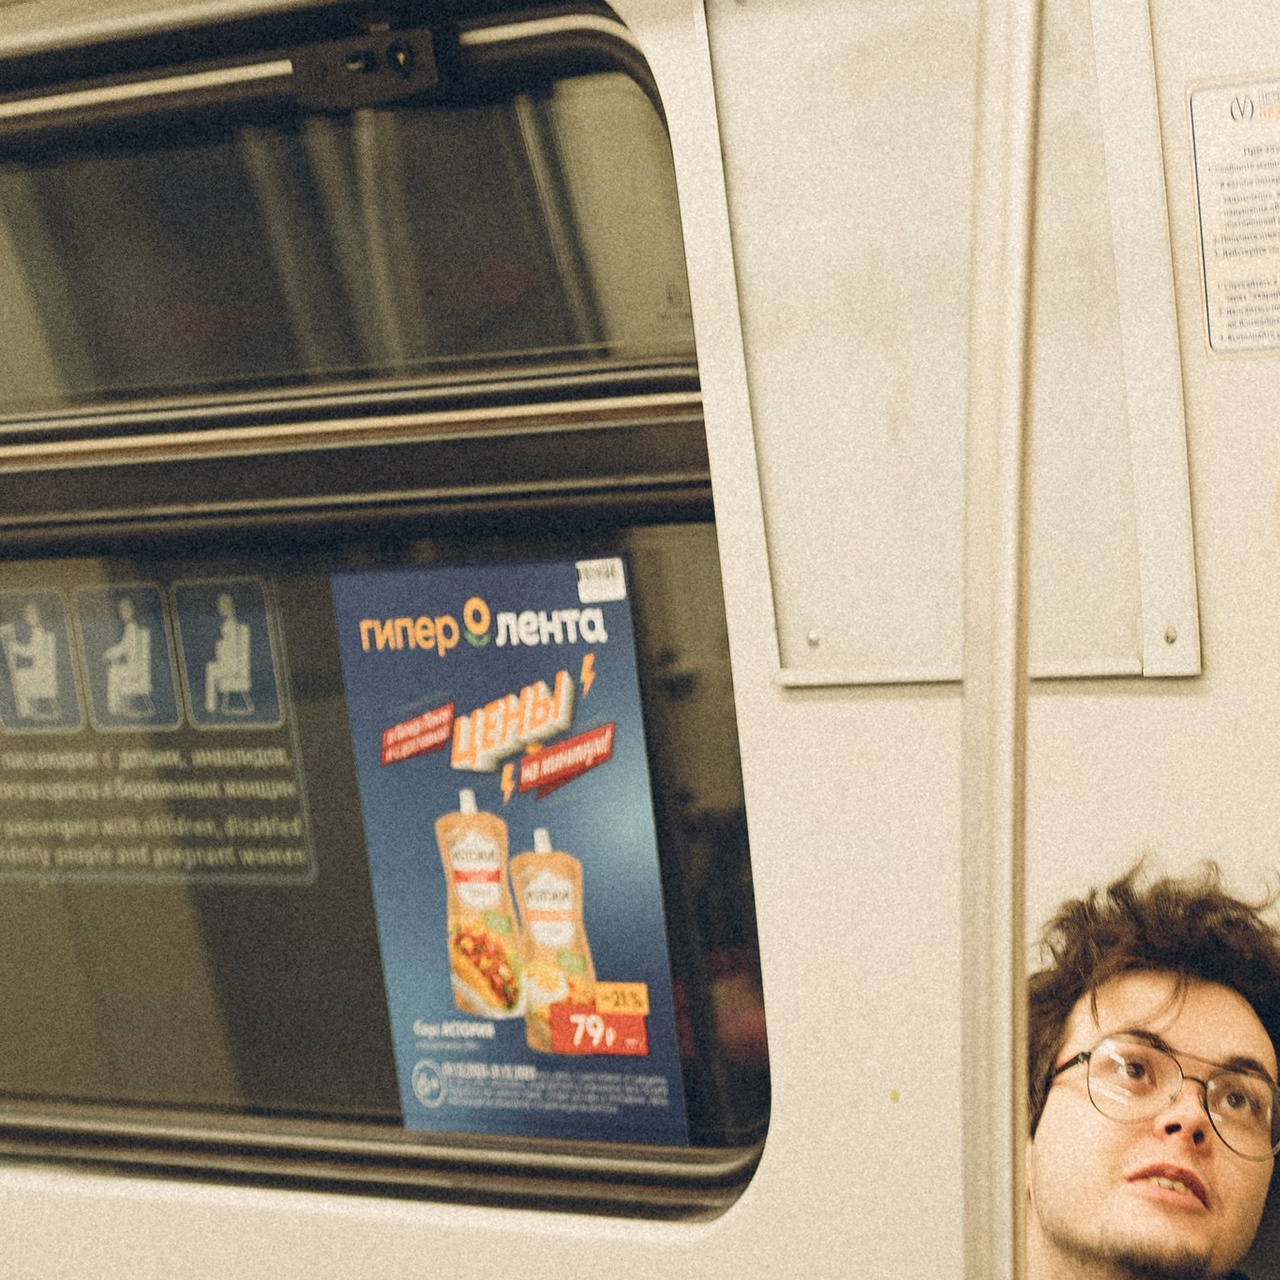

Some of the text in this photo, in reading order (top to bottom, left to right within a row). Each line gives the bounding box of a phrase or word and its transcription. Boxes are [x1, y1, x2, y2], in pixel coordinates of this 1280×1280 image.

[359, 607, 609, 658] гипер лента
[450, 667, 574, 771] ЦЕНЫ
[521, 760, 540, 784] на
